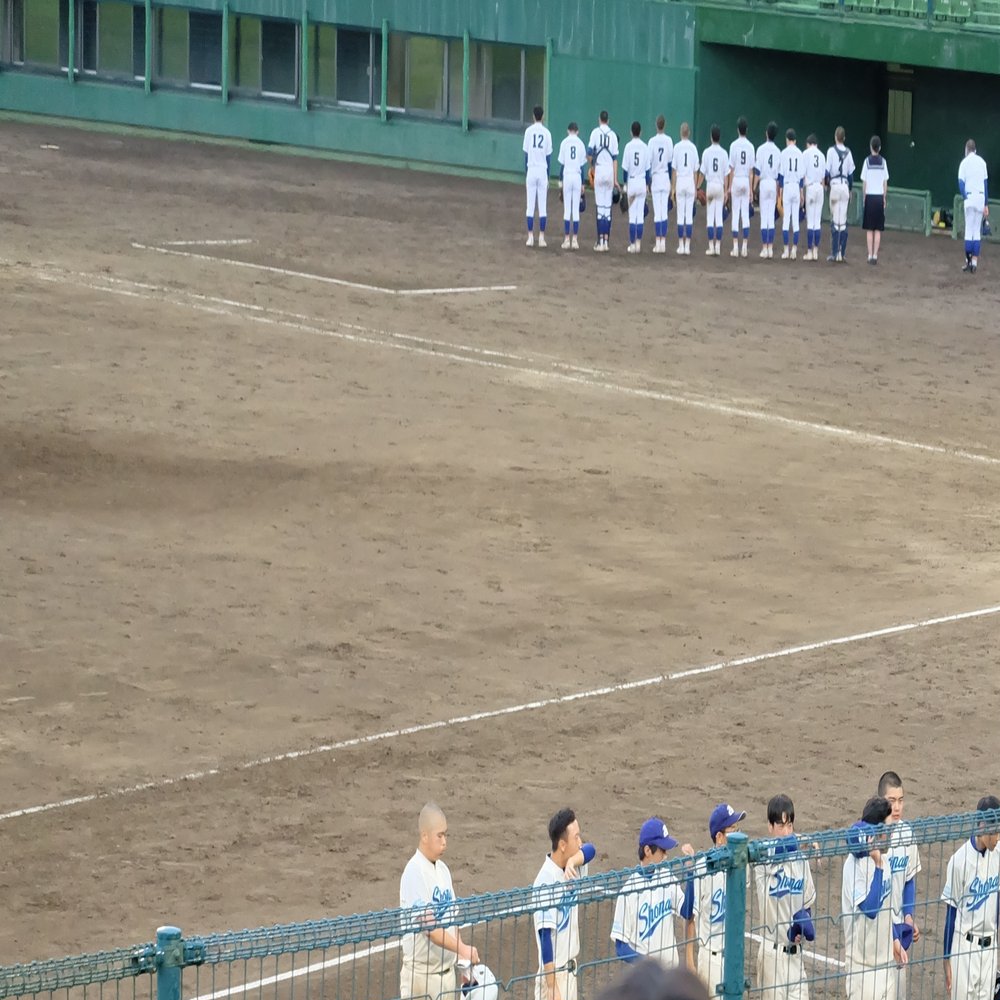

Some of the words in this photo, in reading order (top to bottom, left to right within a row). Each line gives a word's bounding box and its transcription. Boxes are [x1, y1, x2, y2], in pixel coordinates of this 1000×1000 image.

[532, 134, 544, 149] 12
[570, 146, 577, 160] 8
[634, 152, 639, 167] 5
[658, 147, 664, 162] 7
[684, 153, 688, 167] 1
[740, 151, 746, 165] 9
[712, 158, 719, 172] 6
[767, 154, 773, 168] 4
[788, 158, 798, 172] 11
[813, 155, 819, 168] 3
[966, 876, 1000, 911] Shona
[638, 898, 673, 941] Shona
